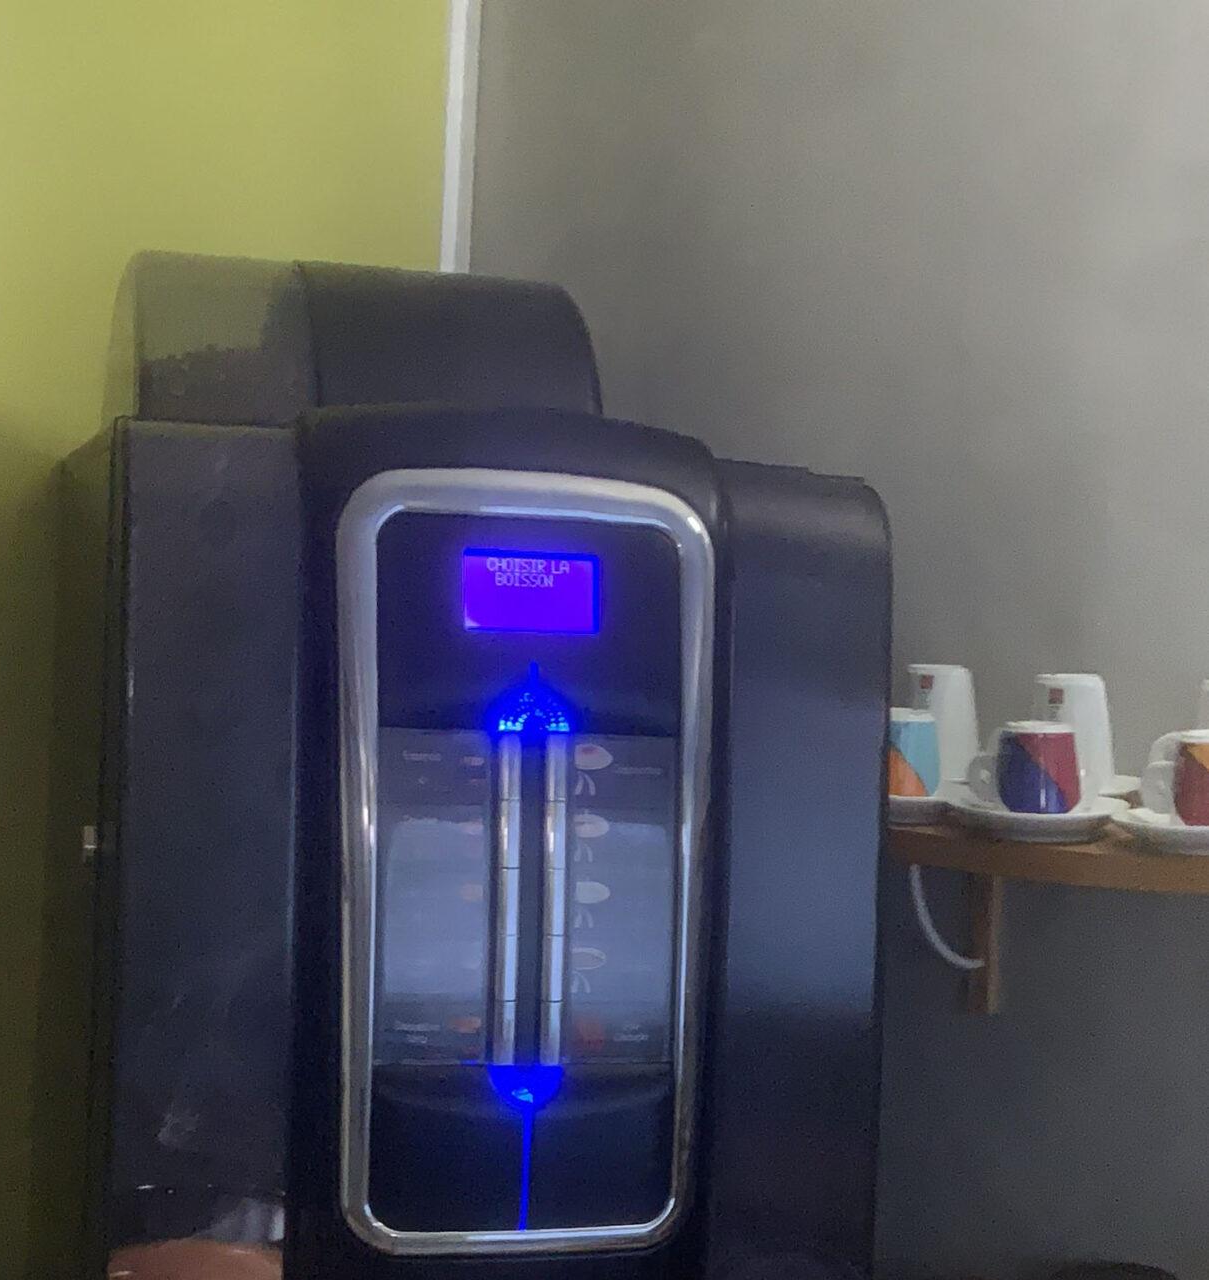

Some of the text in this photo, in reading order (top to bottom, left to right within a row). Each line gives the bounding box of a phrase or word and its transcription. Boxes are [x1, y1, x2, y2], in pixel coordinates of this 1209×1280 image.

[486, 557, 570, 574] CHOISIR LA
[494, 572, 554, 588] BOISSON
